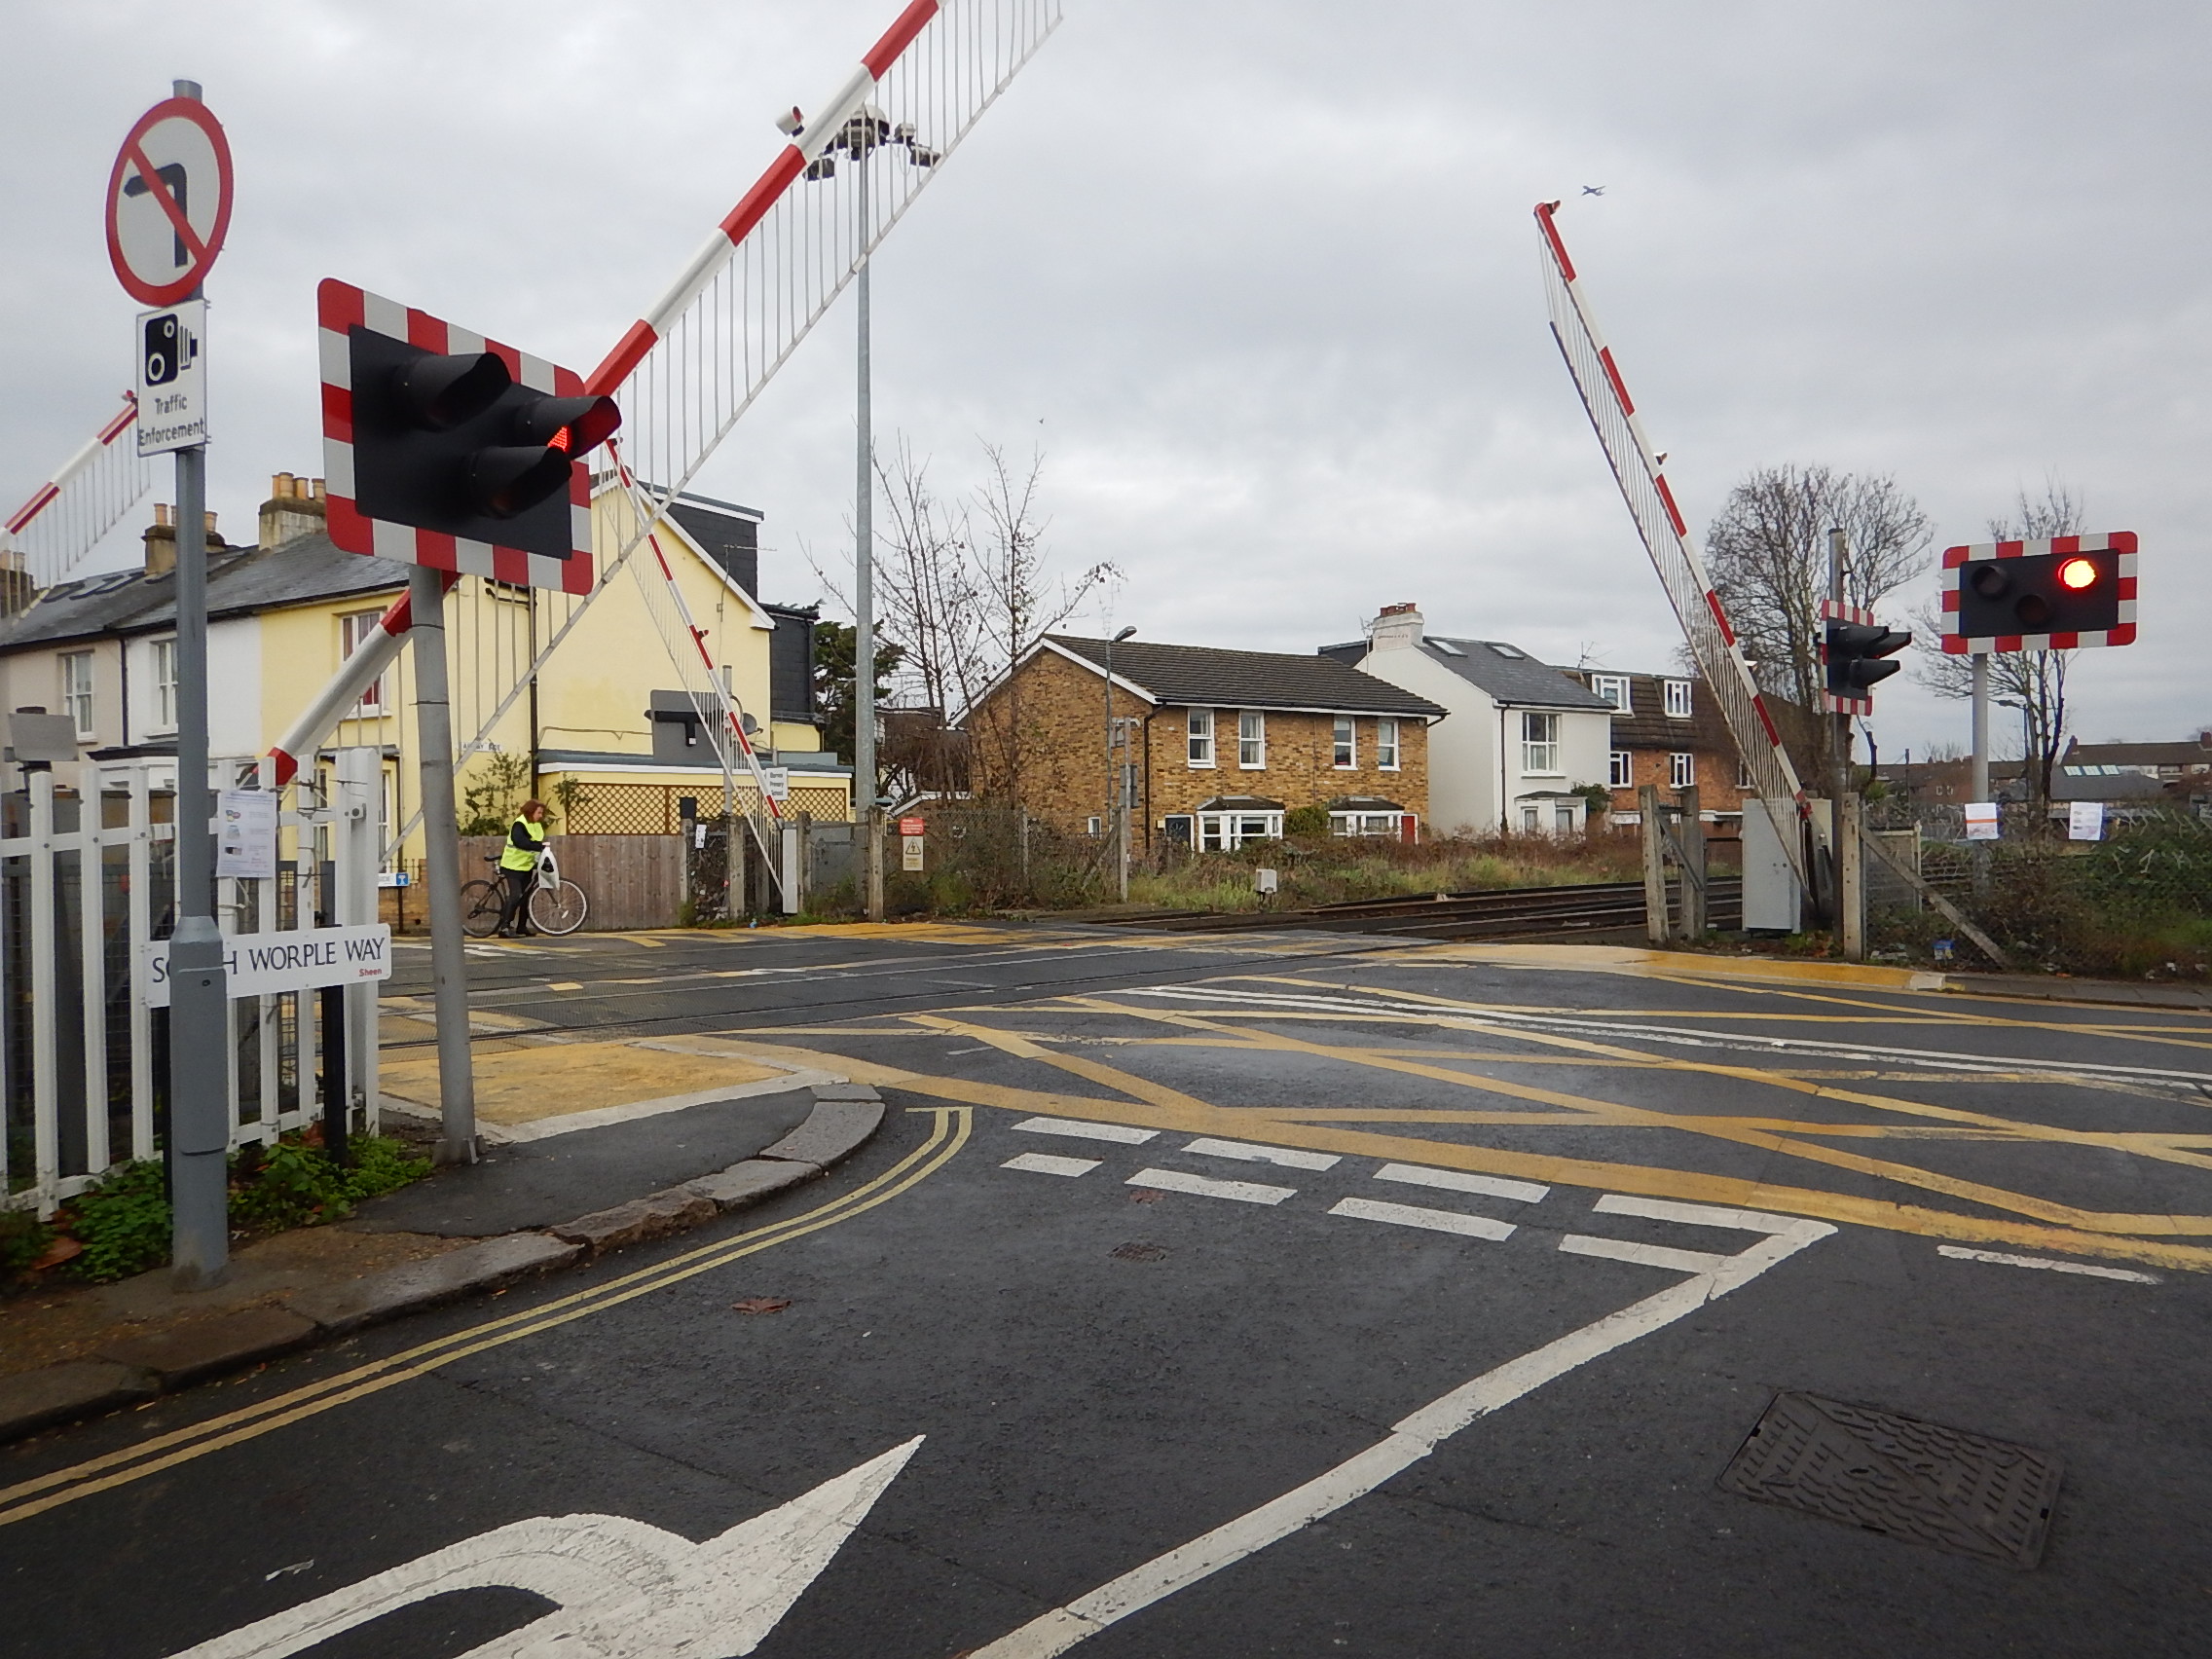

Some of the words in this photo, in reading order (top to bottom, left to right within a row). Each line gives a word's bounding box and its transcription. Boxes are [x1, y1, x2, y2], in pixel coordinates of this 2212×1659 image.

[155, 394, 188, 415] Traffic
[139, 418, 204, 446] Enforcement
[248, 941, 337, 972] WORPLE
[345, 938, 386, 962] WAY
[358, 968, 383, 977] Sheen
